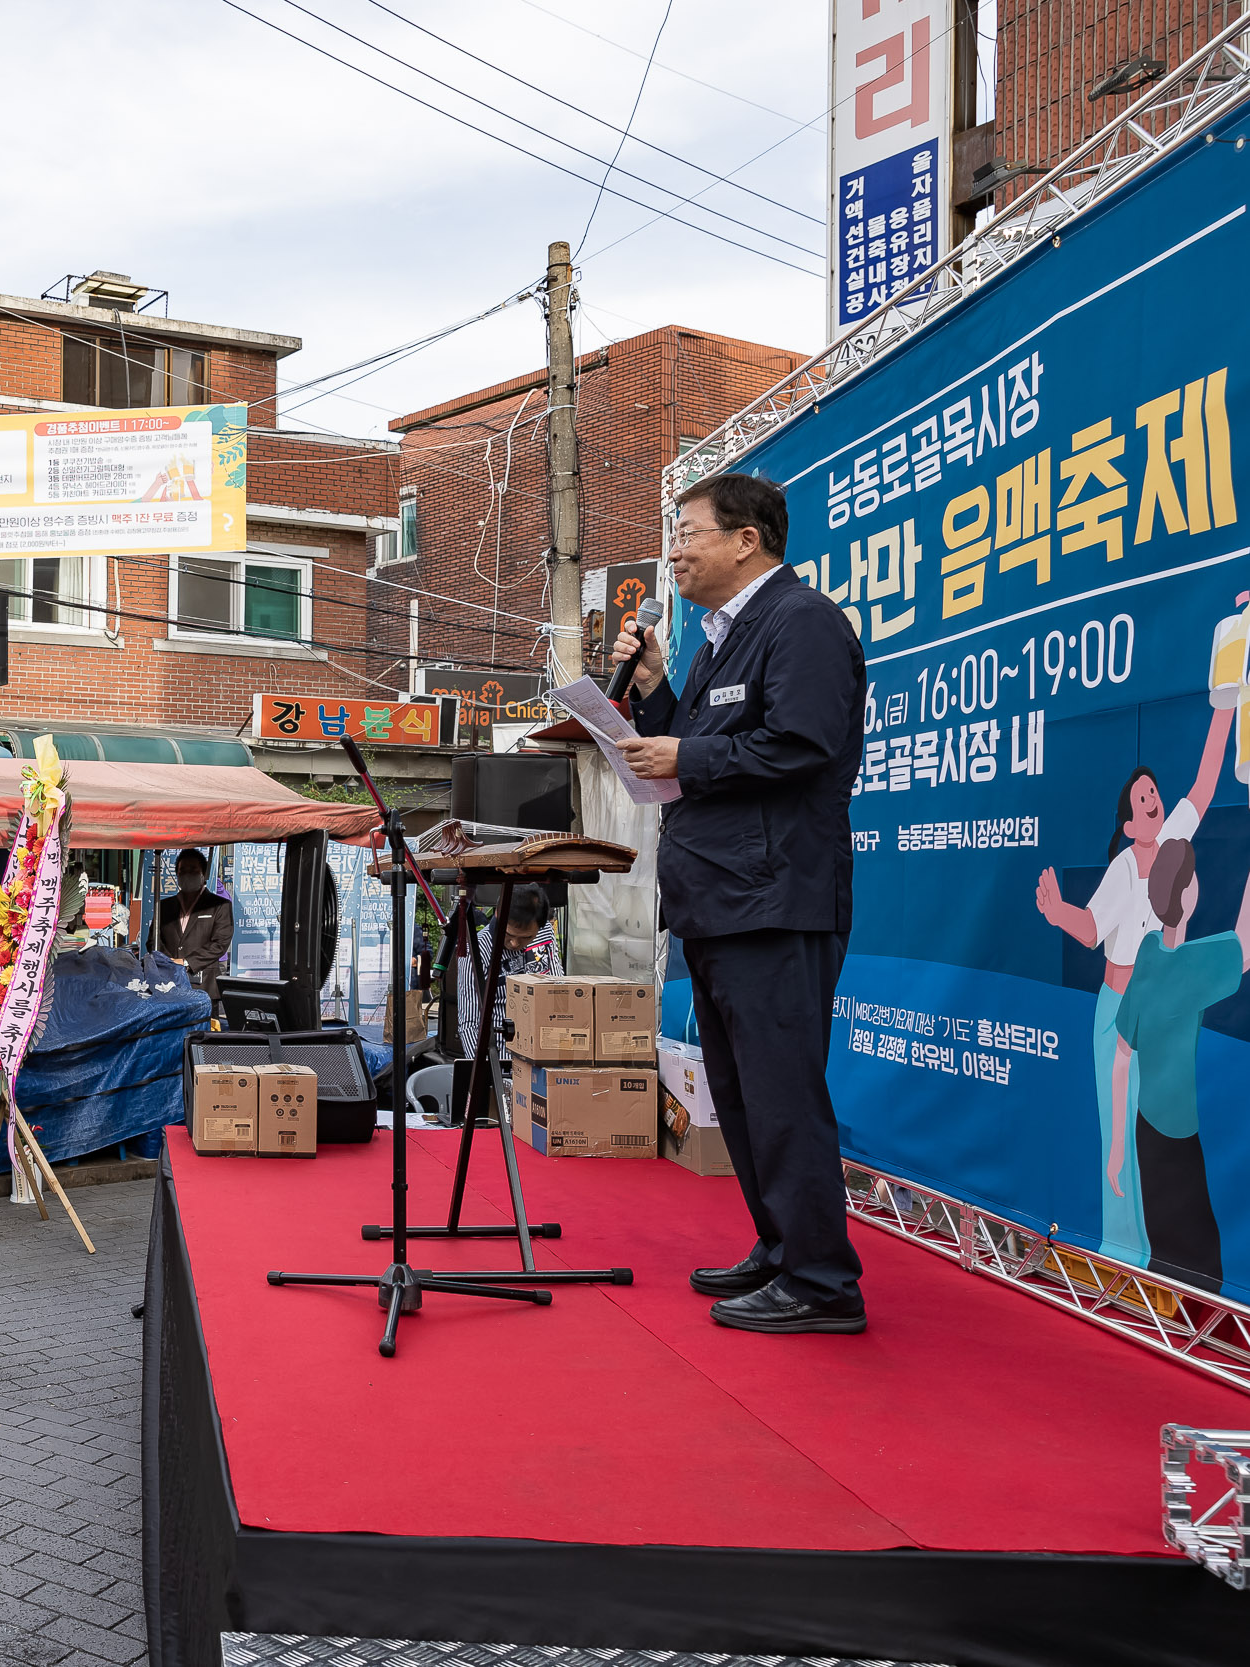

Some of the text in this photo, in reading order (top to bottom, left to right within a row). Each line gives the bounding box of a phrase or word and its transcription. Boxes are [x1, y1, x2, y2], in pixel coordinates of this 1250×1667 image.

[845, 221, 932, 269] 건축유리
[46, 418, 170, 435] 경품추첨이벤트 17:00~
[827, 352, 1043, 530] 능동로골목시장
[48, 467, 60, 475] 2등
[48, 475, 60, 483] 3등
[49, 459, 60, 467] 1등
[48, 483, 60, 491] 4등
[48, 491, 60, 499] 5등
[940, 367, 1237, 620] 음맥축제
[43, 515, 75, 527] 영수증
[77, 513, 109, 526] 증빙시
[111, 513, 133, 524] 맥주
[135, 513, 150, 523] 1잔
[152, 512, 174, 522] 무료
[176, 511, 198, 522] 증정
[917, 613, 1134, 723] 16:00~19:00
[271, 700, 431, 742] 강남분식
[1010, 710, 1045, 775] 내
[897, 815, 1039, 851] 능동로골목시장상인회
[8, 876, 58, 1018] 맥주축제행사를
[855, 1001, 914, 1033] MBC강변가요제
[914, 1012, 935, 1037] 대상
[977, 1018, 1059, 1060] 홍삼트리오
[852, 1028, 1012, 1085] 정일, 김정현, 한유빈, 이현남
[555, 1077, 580, 1086] UNIX
